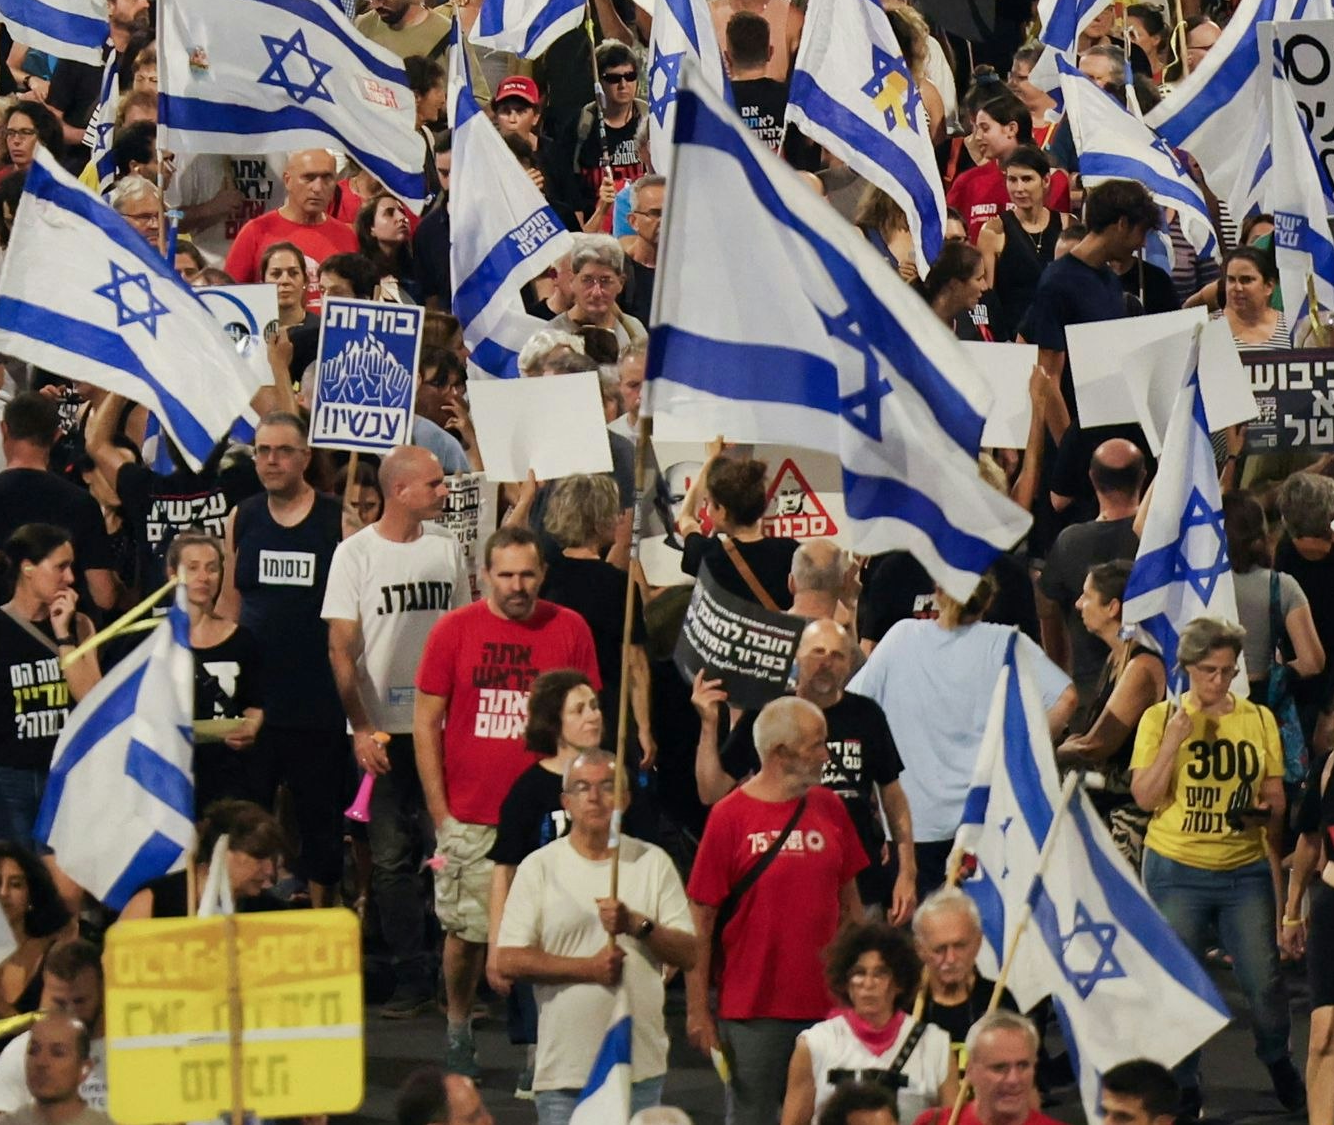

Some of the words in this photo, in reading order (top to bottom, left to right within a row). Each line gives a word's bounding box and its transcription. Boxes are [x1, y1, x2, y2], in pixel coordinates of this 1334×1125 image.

[508, 210, 551, 241] חופשי
[517, 221, 558, 257] בארצנו
[326, 305, 416, 336] בחירות
[322, 406, 402, 441] עכשיו!
[482, 642, 532, 667] אתה
[742, 629, 793, 656] חובה
[35, 657, 61, 684] מה
[734, 645, 787, 671] בטרור
[9, 663, 35, 688] הם
[472, 665, 539, 691] הראש
[12, 679, 69, 714] עדיין
[478, 688, 531, 715] אתה
[474, 712, 528, 740] אשם
[1187, 738, 1259, 782] 300
[1186, 785, 1221, 809] ימים
[1181, 810, 1224, 834] בעזה
